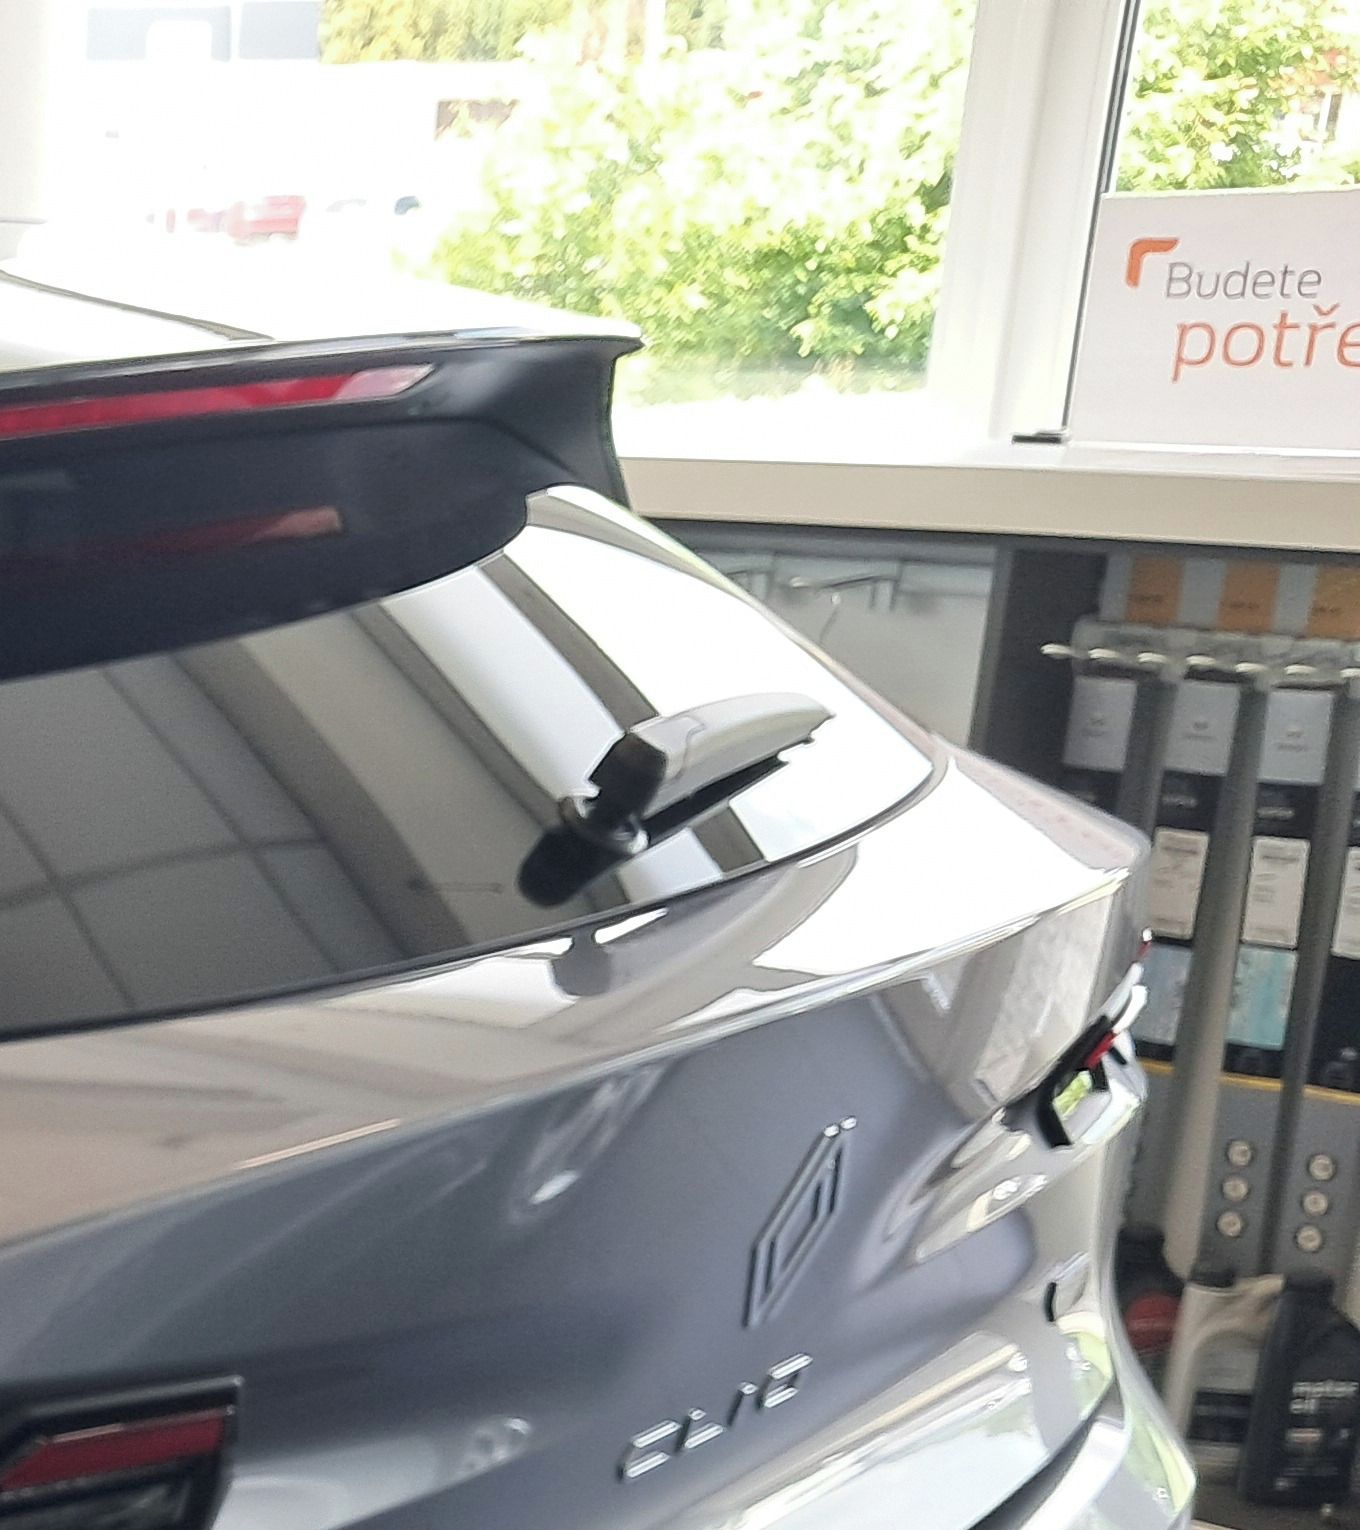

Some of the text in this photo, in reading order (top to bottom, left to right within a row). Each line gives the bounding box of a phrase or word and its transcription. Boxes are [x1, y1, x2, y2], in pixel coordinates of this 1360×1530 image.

[1165, 260, 1323, 300] Budete
[1169, 302, 1360, 385] potře
[616, 1352, 814, 1483] CLIO
